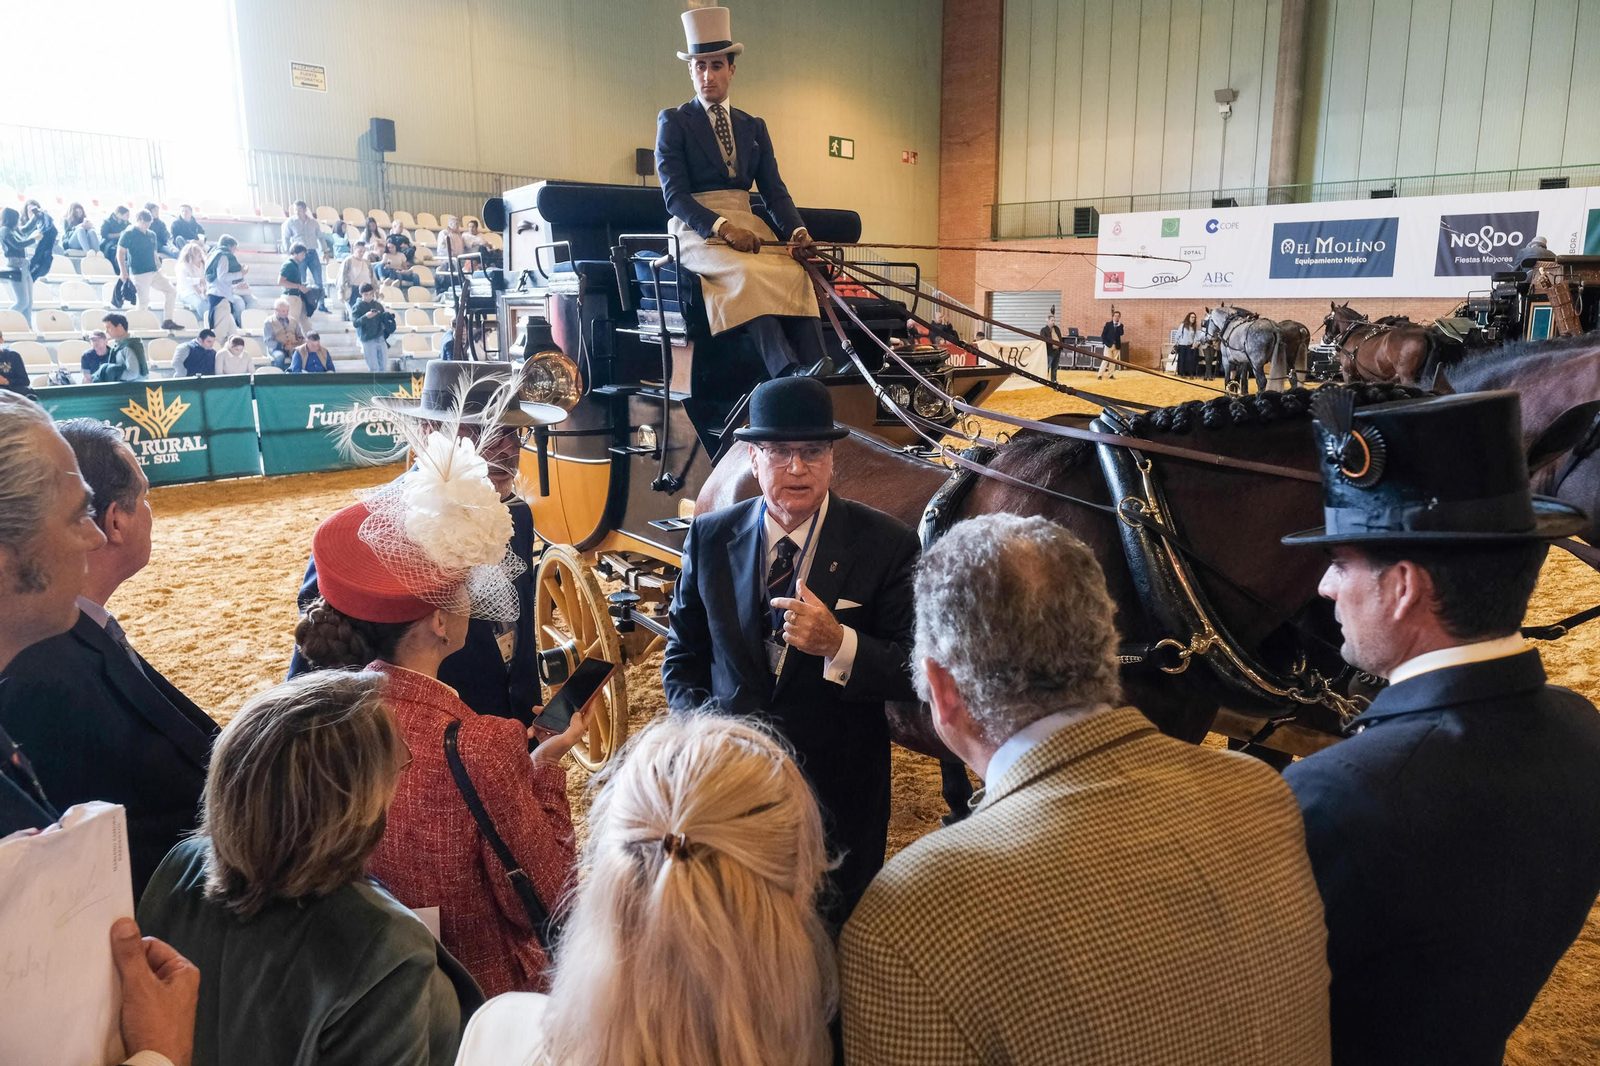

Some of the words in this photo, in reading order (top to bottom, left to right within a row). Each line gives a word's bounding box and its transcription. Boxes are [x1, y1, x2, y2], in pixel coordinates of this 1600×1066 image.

[1220, 222, 1239, 230] COPE
[1569, 231, 1578, 254] BORA
[1297, 243, 1310, 254] EL
[1295, 257, 1343, 266] Equipamiento
[1344, 256, 1367, 265] Hípico
[1454, 256, 1480, 264] Fiestas
[1482, 256, 1513, 264] Mayores
[1152, 275, 1178, 284] OTON
[1203, 272, 1234, 283] ABC
[140, 436, 207, 456] RURAL
[153, 452, 180, 465] SUR
